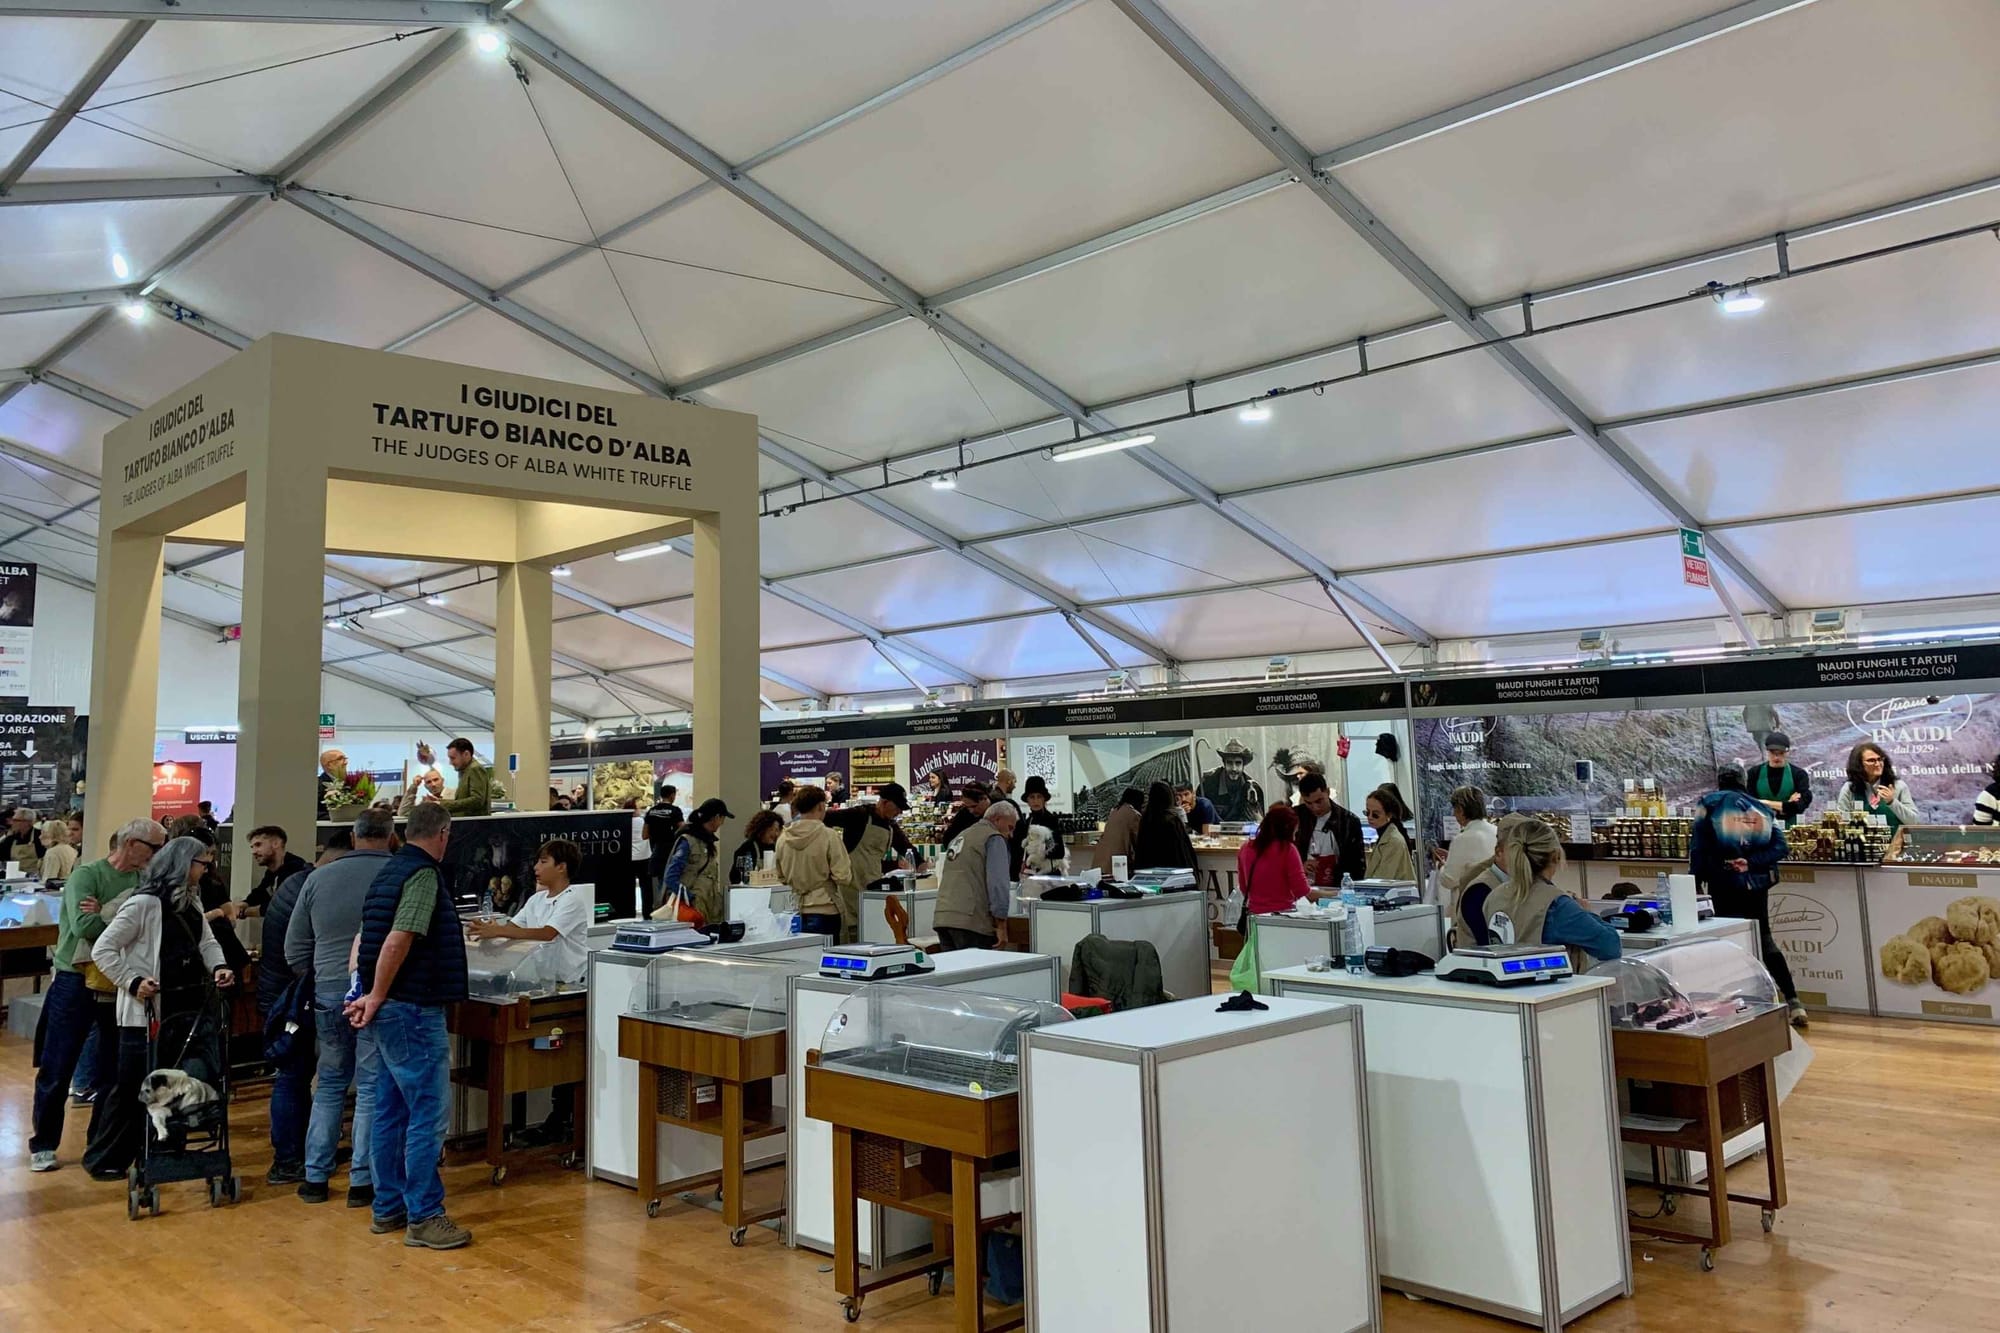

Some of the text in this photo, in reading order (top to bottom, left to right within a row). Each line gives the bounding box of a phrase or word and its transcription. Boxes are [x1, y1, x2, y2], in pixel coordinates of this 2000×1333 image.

[461, 384, 617, 427] I GIUDICI DEL
[149, 394, 204, 441] I GIUDICI DEL
[372, 402, 500, 440] TARTUFO
[505, 422, 603, 454] BIANCO
[124, 449, 161, 483] TARTUFO
[161, 428, 198, 464] BIANCO
[166, 467, 183, 486] ALBA
[183, 455, 205, 478] WHITE
[206, 440, 235, 467] TRUFFLE
[372, 436, 692, 491] THE JUDGES OF ALBA WHITE TRUFFLE
[1817, 654, 1958, 671] INAUDI FUNGHI E TARTUFI
[1820, 665, 1956, 681] BORGO SAN DALMAZZO (CN)
[1496, 677, 1600, 689] INAUDI FUNGHI E TARTUFI
[1498, 691, 1524, 699] BORGO
[1540, 688, 1579, 697] DALMAZZO
[7, 726, 35, 734] AREA
[1871, 726, 1953, 743] INAUDI
[942, 748, 969, 768] Sapori
[970, 749, 980, 766] di
[1951, 763, 1982, 774] della
[1921, 876, 1964, 886] INAUDI
[1801, 967, 1844, 980] Tartufi
